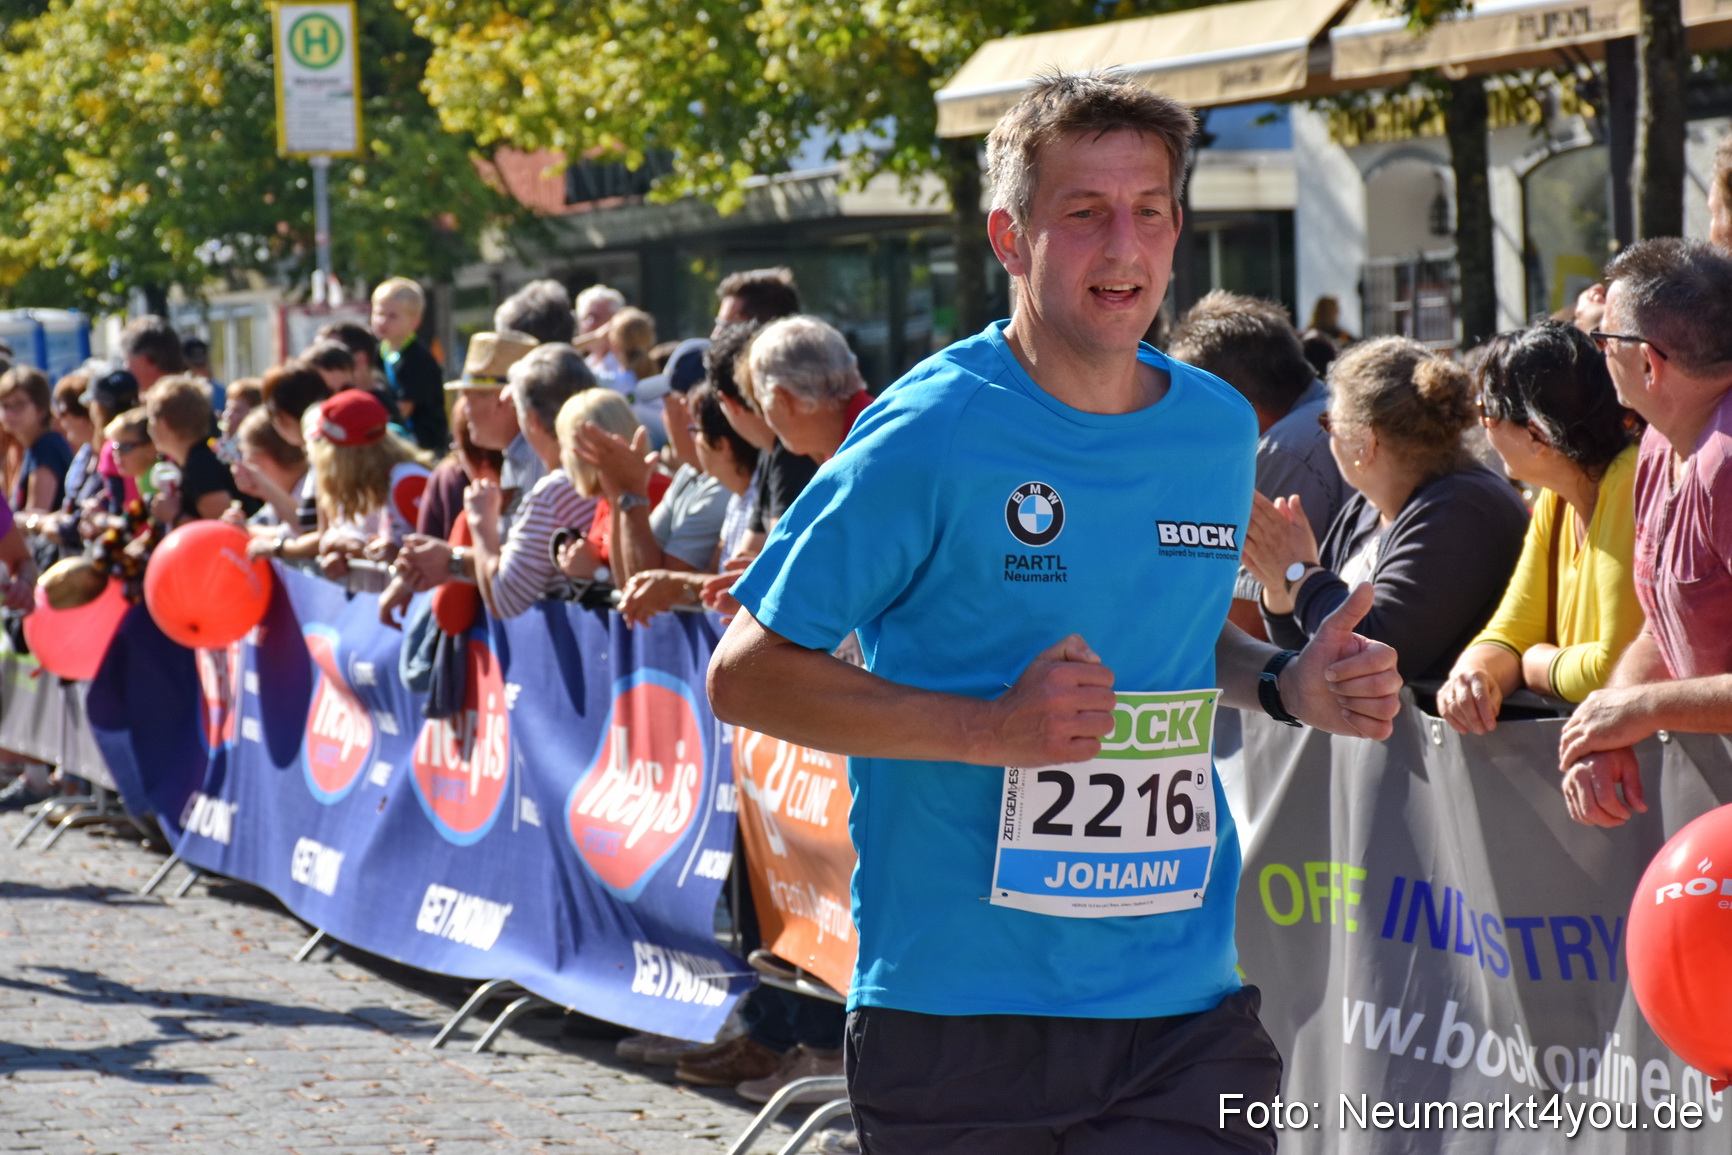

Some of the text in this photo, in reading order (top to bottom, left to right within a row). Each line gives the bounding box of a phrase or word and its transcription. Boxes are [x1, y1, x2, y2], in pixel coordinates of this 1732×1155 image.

[1011, 484, 1060, 506] BMW
[1156, 522, 1237, 549] BOCK
[1005, 554, 1068, 571] PARTL
[1159, 548, 1187, 558] inspired
[1188, 549, 1196, 558] by
[1197, 550, 1214, 559] smart
[1004, 570, 1068, 583] Neumarkt
[1101, 702, 1202, 748] OCK
[1032, 769, 1195, 838] 2216
[1044, 860, 1181, 890] JOHANN
